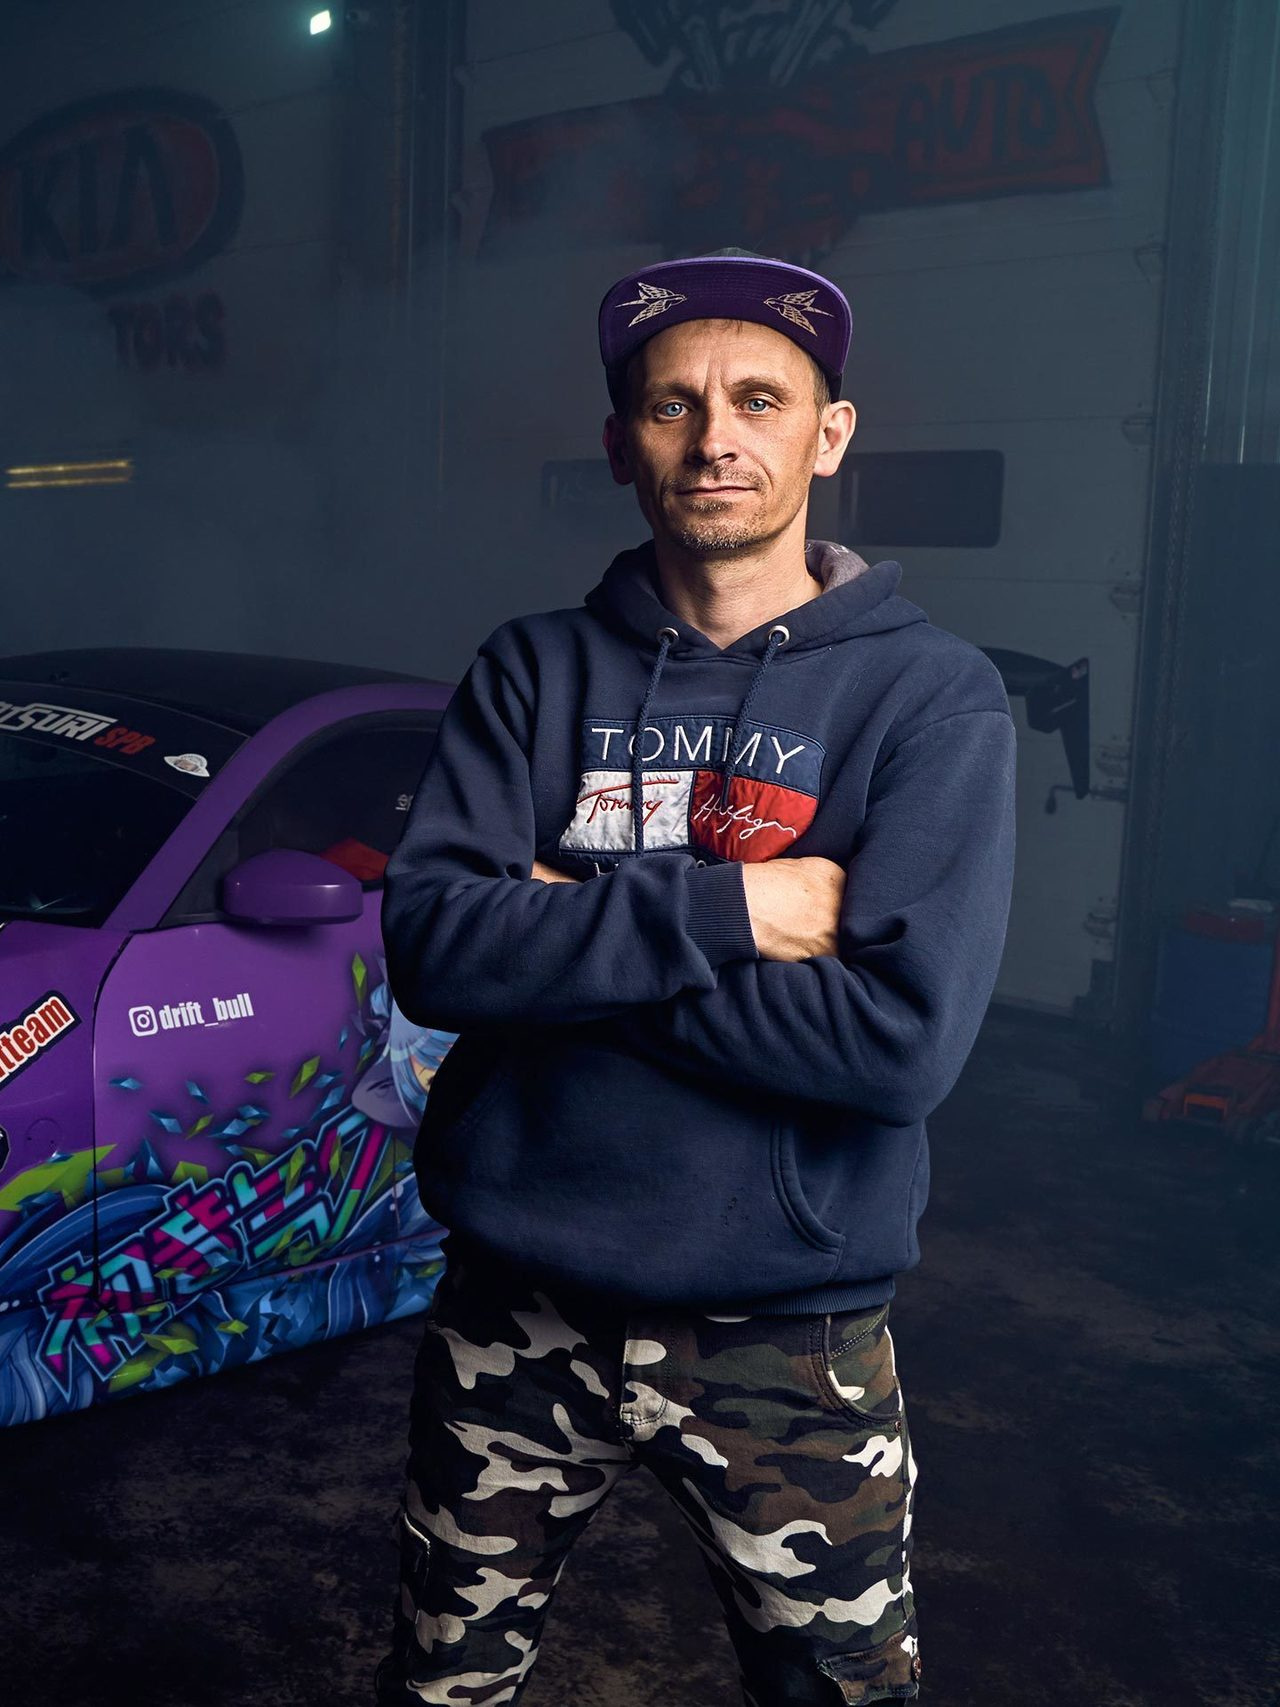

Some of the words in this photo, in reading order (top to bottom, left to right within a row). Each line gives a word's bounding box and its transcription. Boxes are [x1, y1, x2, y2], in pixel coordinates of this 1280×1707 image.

[20, 124, 180, 264] KIA
[92, 725, 158, 757] SPB
[591, 724, 806, 775] TOMMY
[577, 780, 680, 826] Tomy
